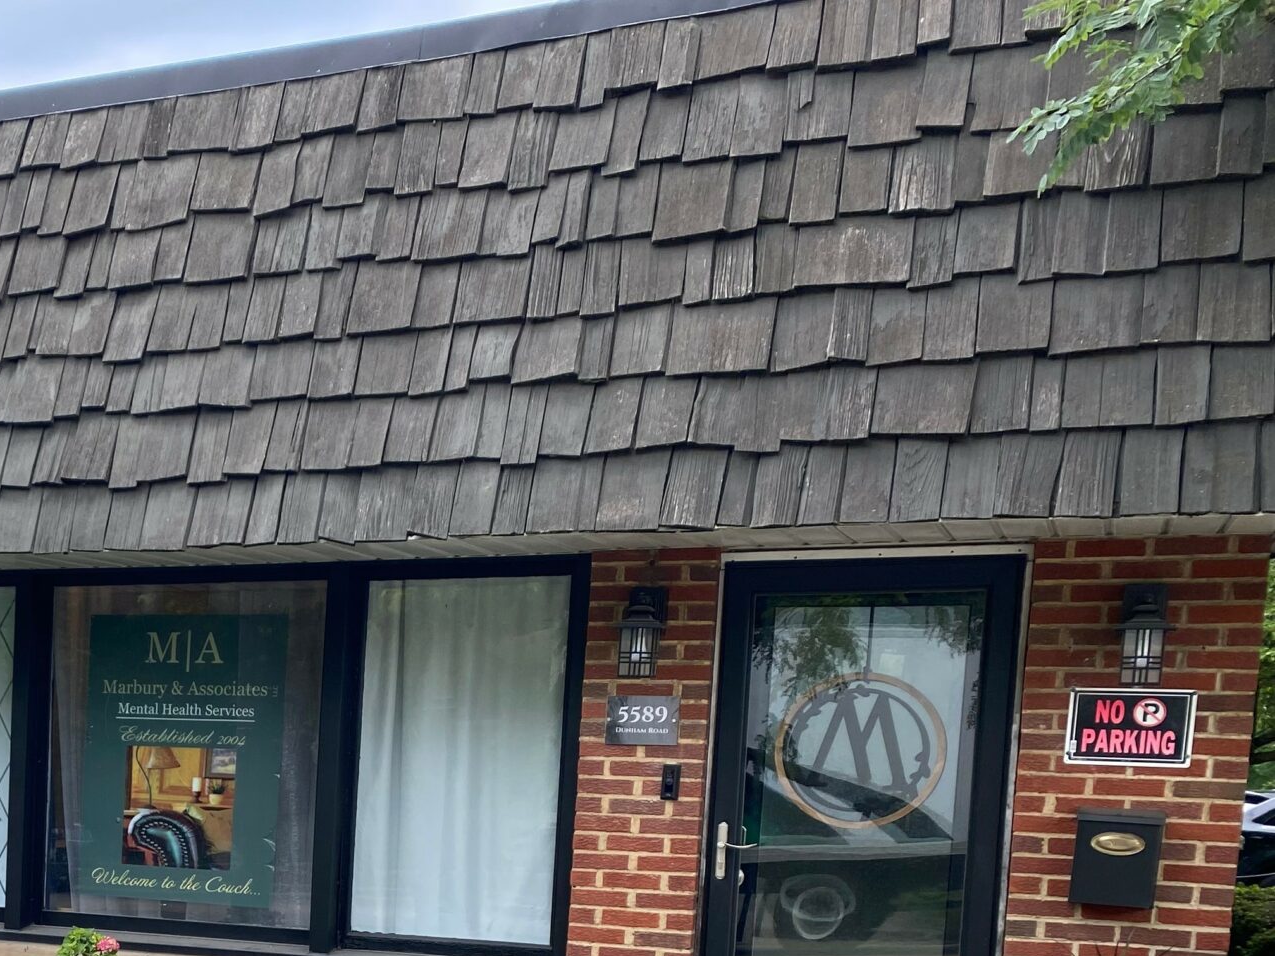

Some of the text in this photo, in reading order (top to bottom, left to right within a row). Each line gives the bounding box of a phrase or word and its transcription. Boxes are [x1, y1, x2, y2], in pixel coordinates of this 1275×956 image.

[102, 679, 168, 699] Marbury
[171, 681, 183, 696] &
[187, 681, 268, 697] Associates
[118, 702, 255, 718] Mental Health Services
[617, 705, 668, 723] 5589
[1095, 699, 1125, 724] NO
[119, 725, 247, 747] Established 2004
[1080, 728, 1176, 755] PARKING
[91, 867, 261, 896] Welcome to the Couch...
